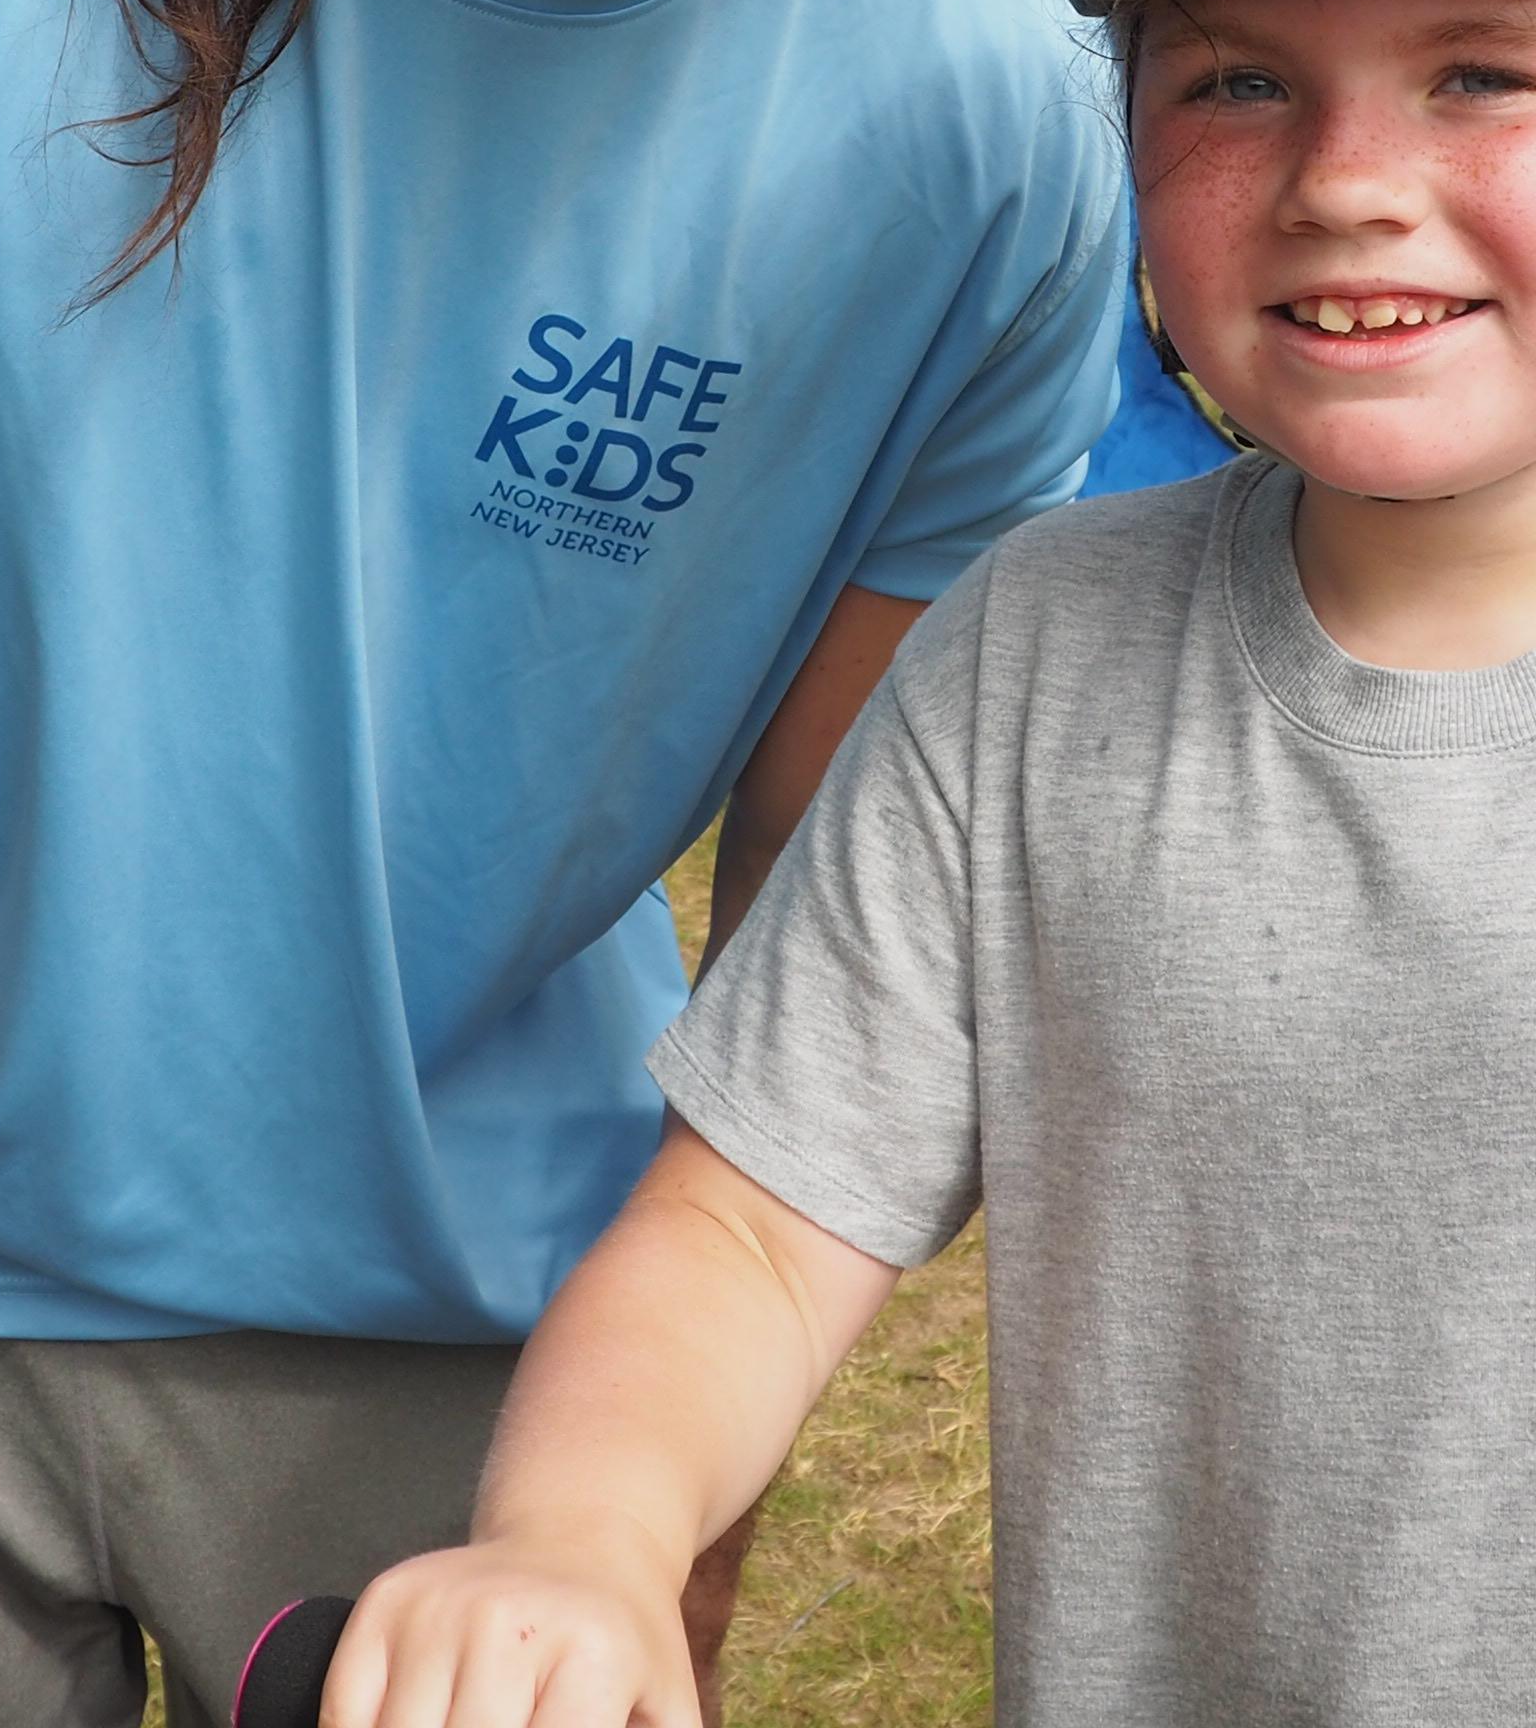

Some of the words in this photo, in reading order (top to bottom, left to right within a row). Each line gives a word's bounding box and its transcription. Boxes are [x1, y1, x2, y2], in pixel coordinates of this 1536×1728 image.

[511, 314, 742, 433] SAFE
[470, 501, 541, 539] NEW
[545, 527, 650, 566] JERSEY
[489, 480, 656, 540] NORTHERN
